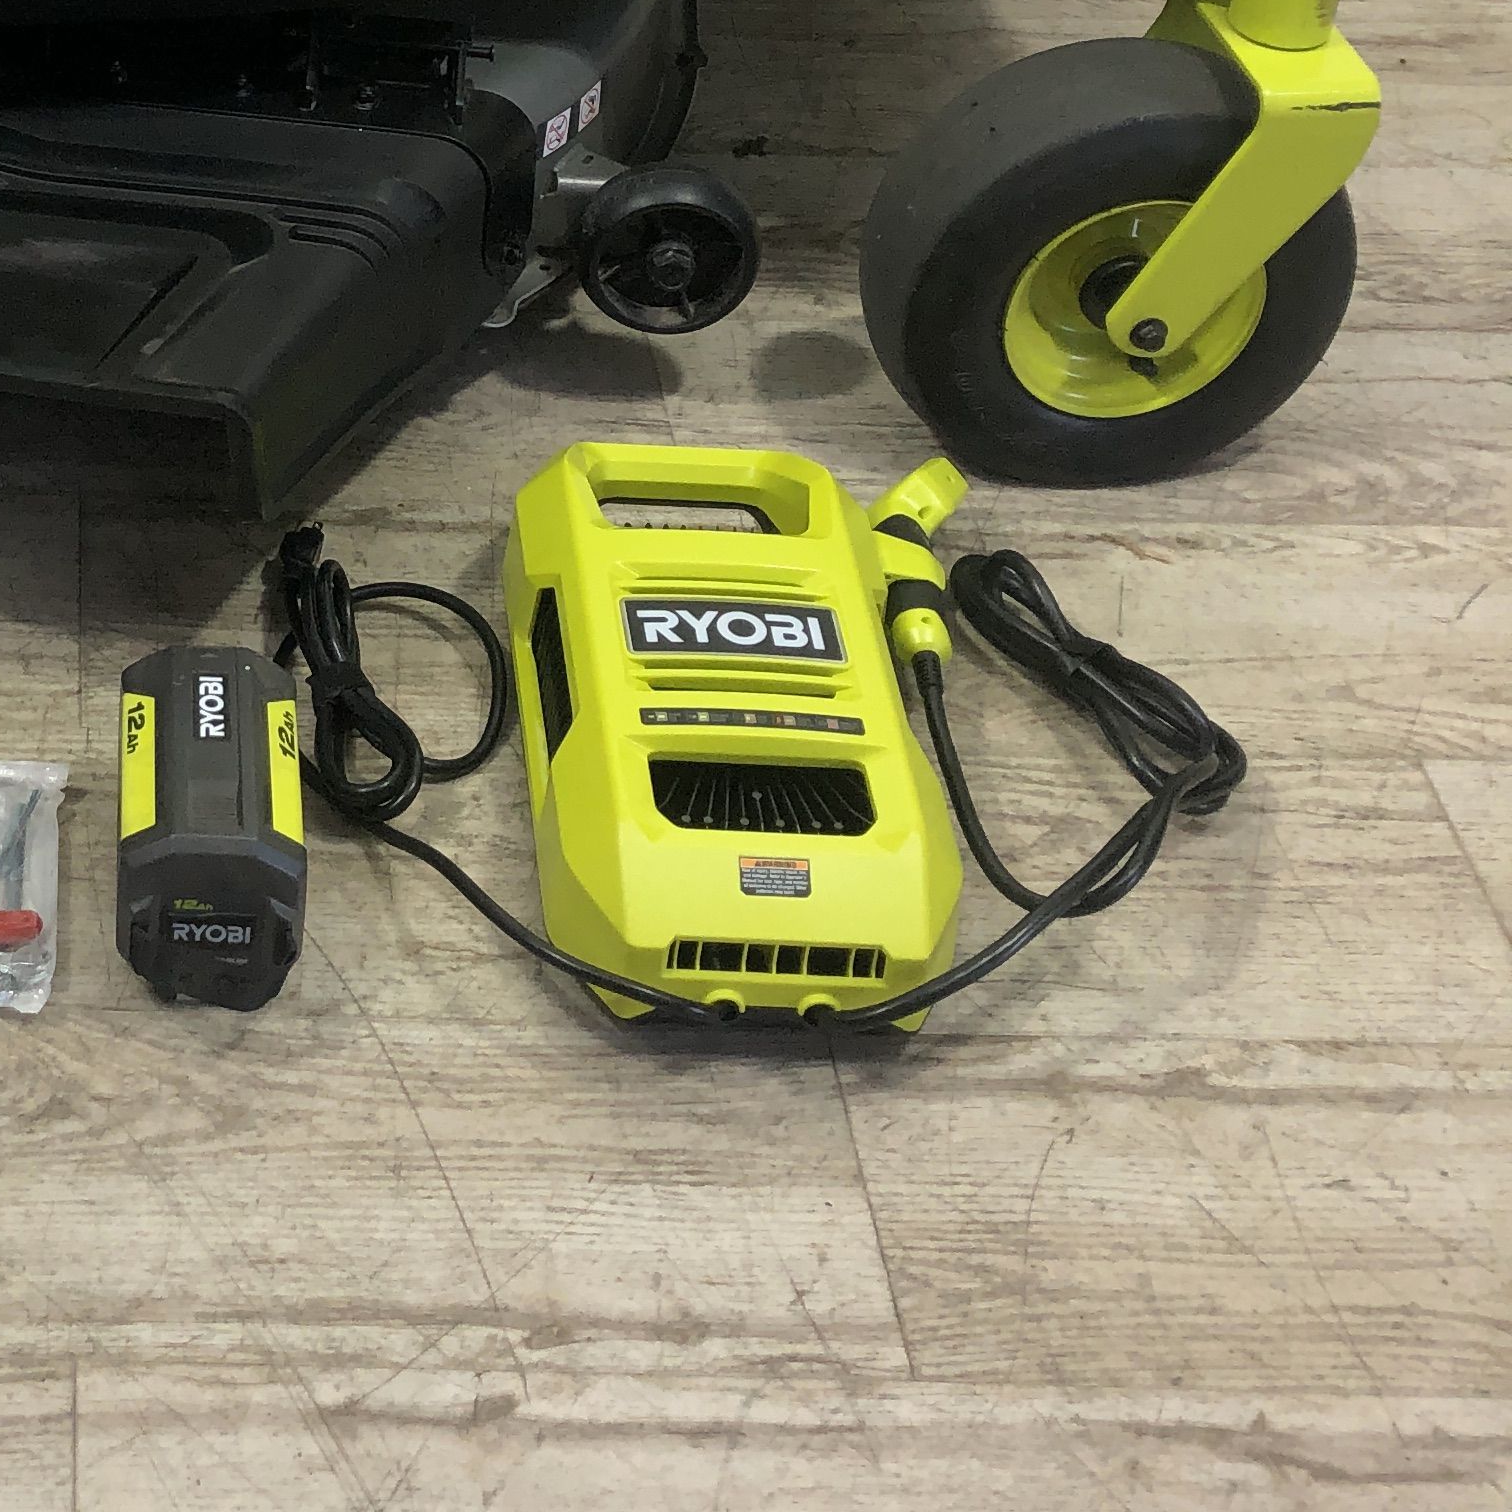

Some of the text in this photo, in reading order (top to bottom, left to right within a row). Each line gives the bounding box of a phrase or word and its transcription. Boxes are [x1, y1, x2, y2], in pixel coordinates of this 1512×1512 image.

[635, 608, 826, 651] RYOBI
[127, 701, 145, 755] 12Ah
[199, 676, 225, 737] RYOBI
[278, 711, 296, 760] 12Ah
[172, 923, 252, 945] RYOBI
